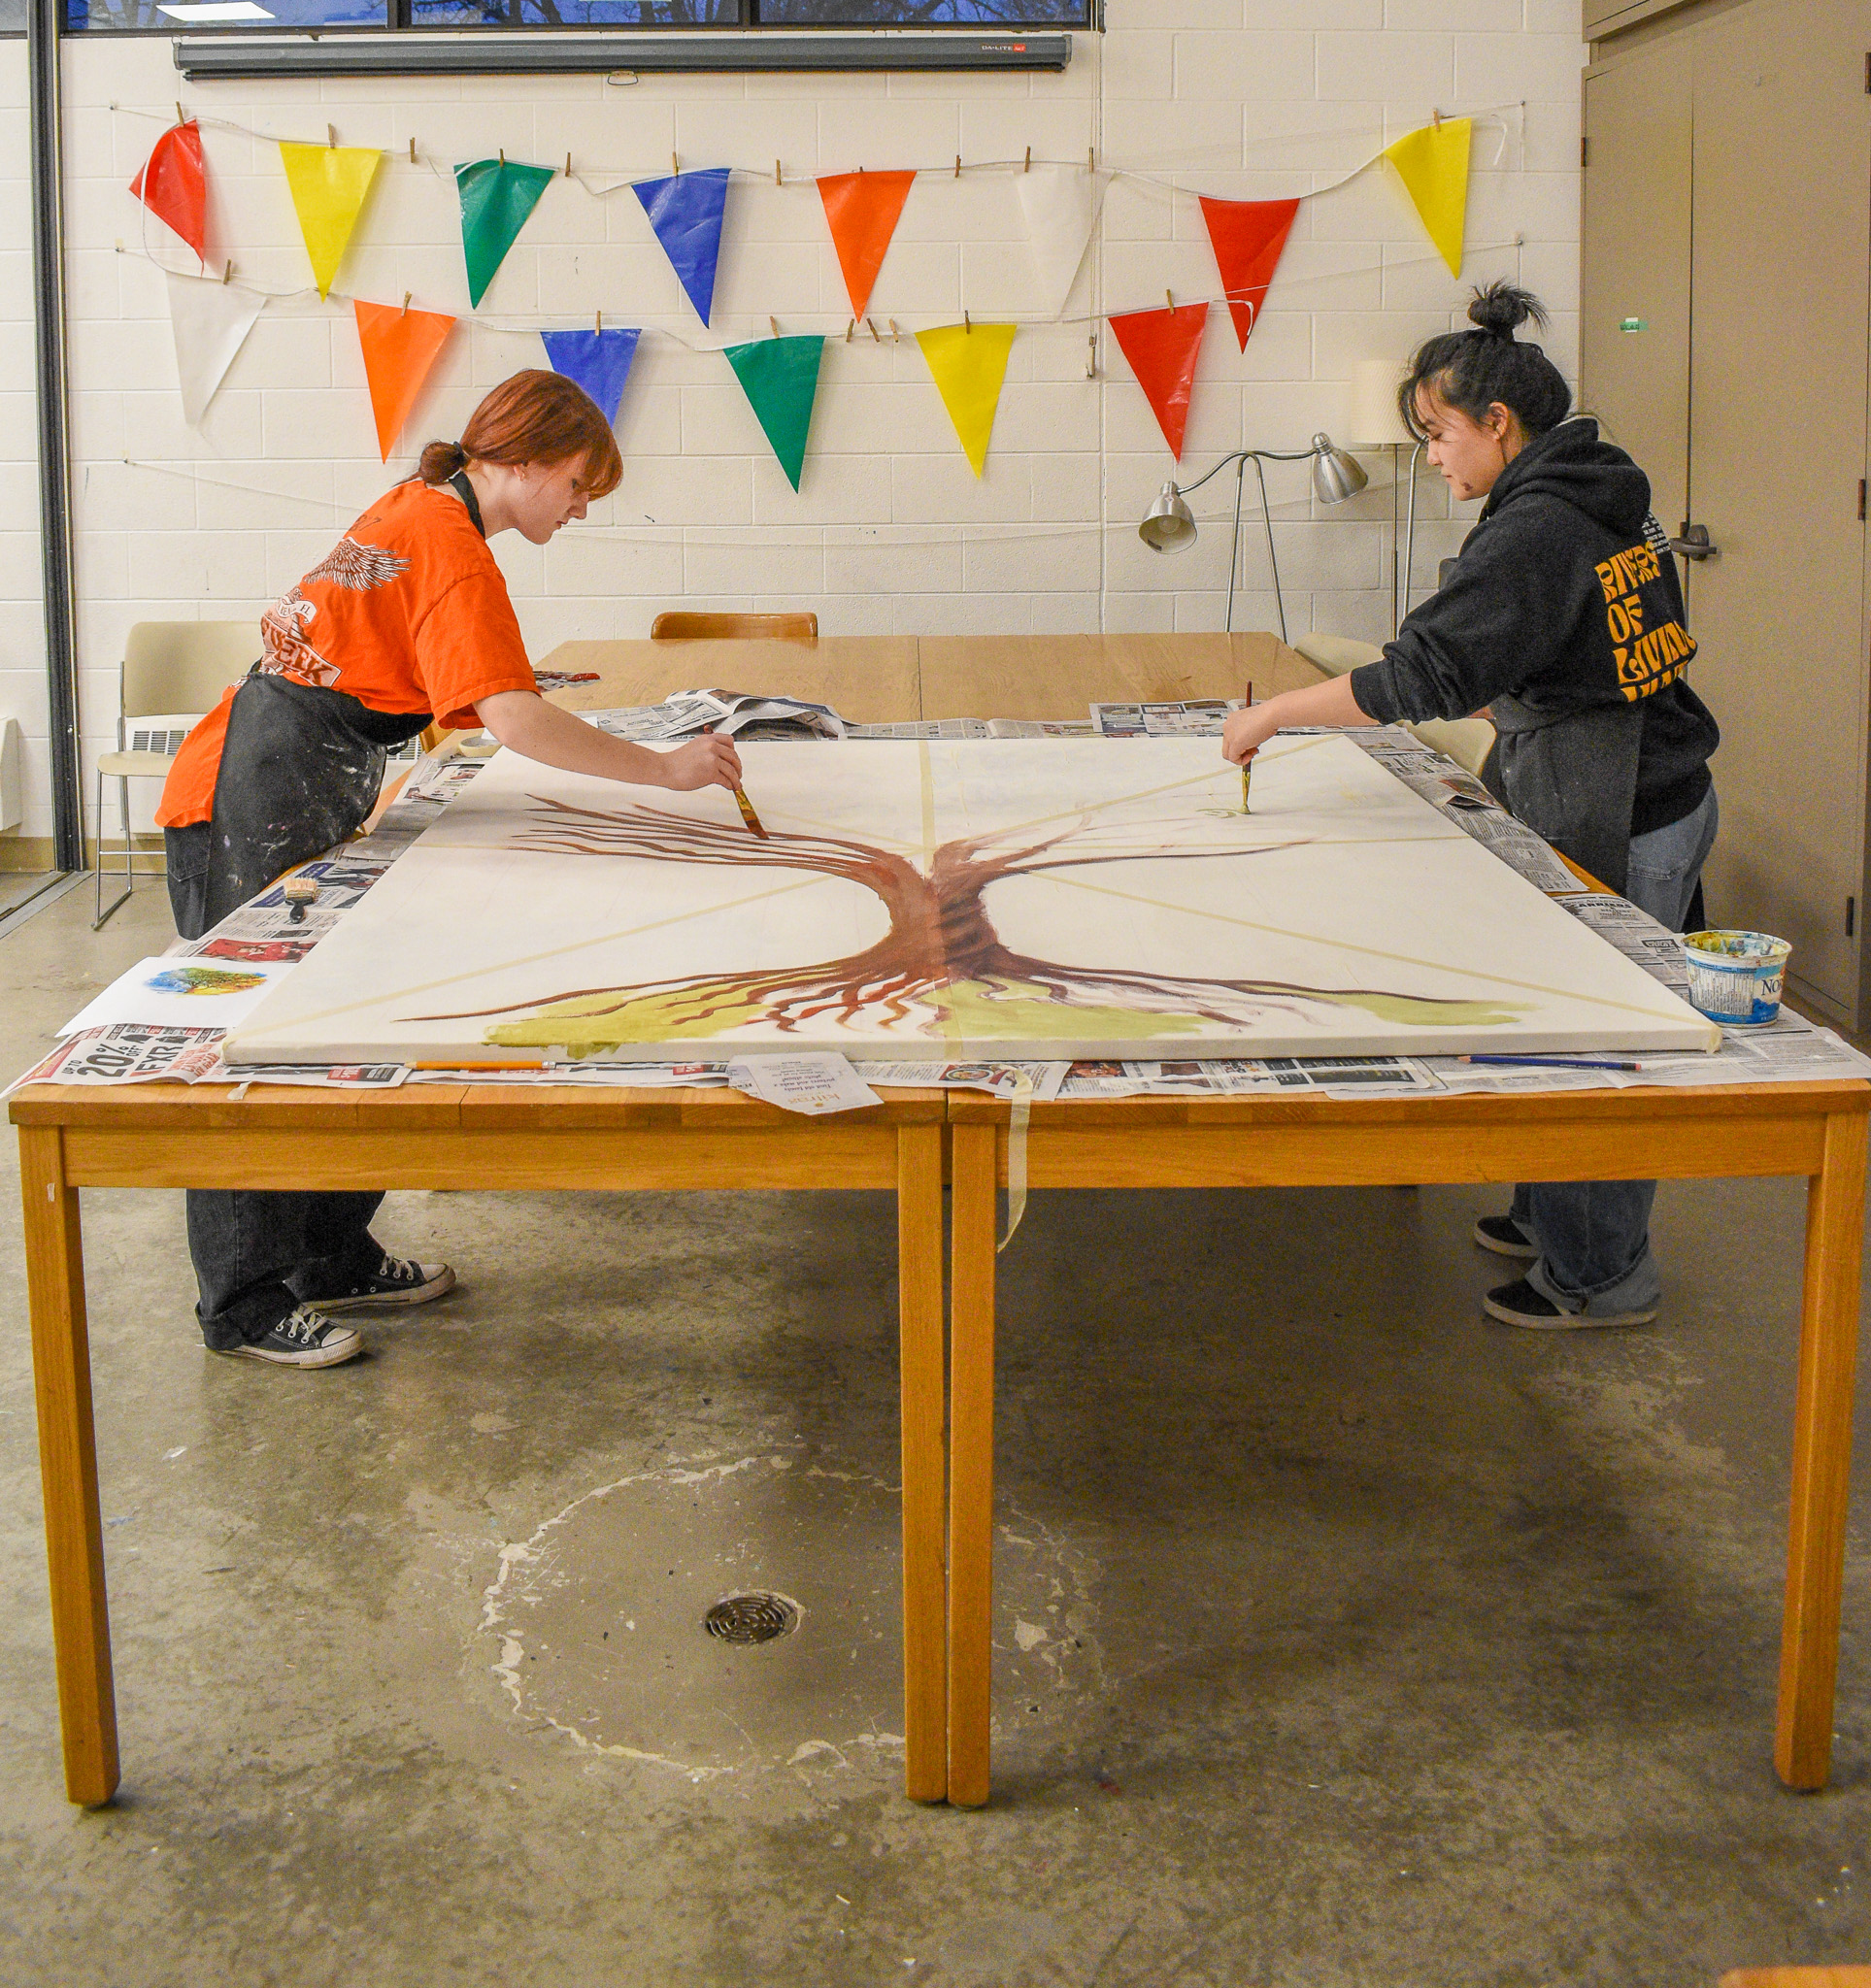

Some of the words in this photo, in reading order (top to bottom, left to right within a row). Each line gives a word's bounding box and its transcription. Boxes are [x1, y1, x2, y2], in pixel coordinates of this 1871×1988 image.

[300, 604, 311, 615] FL
[1607, 593, 1644, 644] OF
[77, 1044, 136, 1077] 20%
[134, 1045, 184, 1072] FXR
